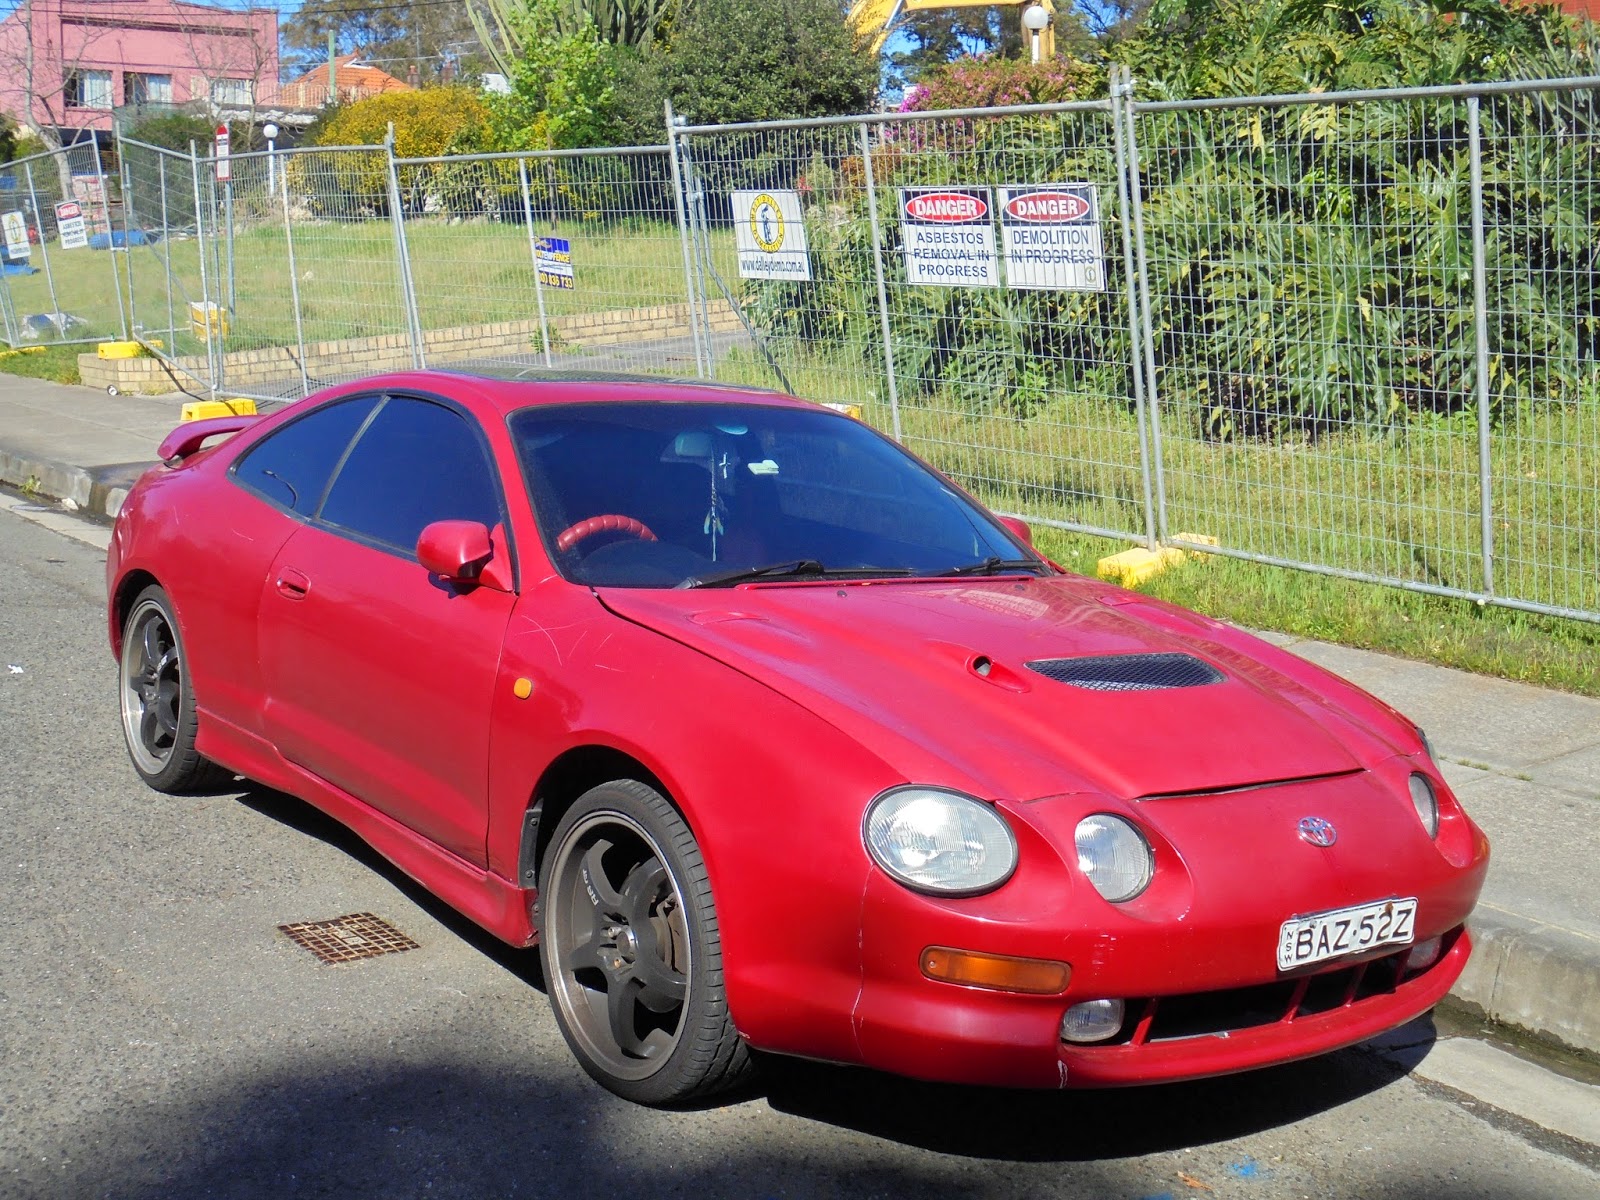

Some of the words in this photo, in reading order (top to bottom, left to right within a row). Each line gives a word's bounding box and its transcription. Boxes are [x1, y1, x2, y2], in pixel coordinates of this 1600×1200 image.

[915, 198, 978, 217] DANGER
[1016, 198, 1079, 215] DANGER
[916, 231, 984, 245] ASBESTOS
[1013, 229, 1089, 245] DEMOLITION
[914, 247, 974, 261] REMOVAL
[977, 249, 990, 262] IN
[1011, 249, 1023, 263] IN
[1026, 249, 1096, 265] PROGRESS
[918, 264, 988, 278] PROGRESS
[1284, 930, 1294, 964] NSW
